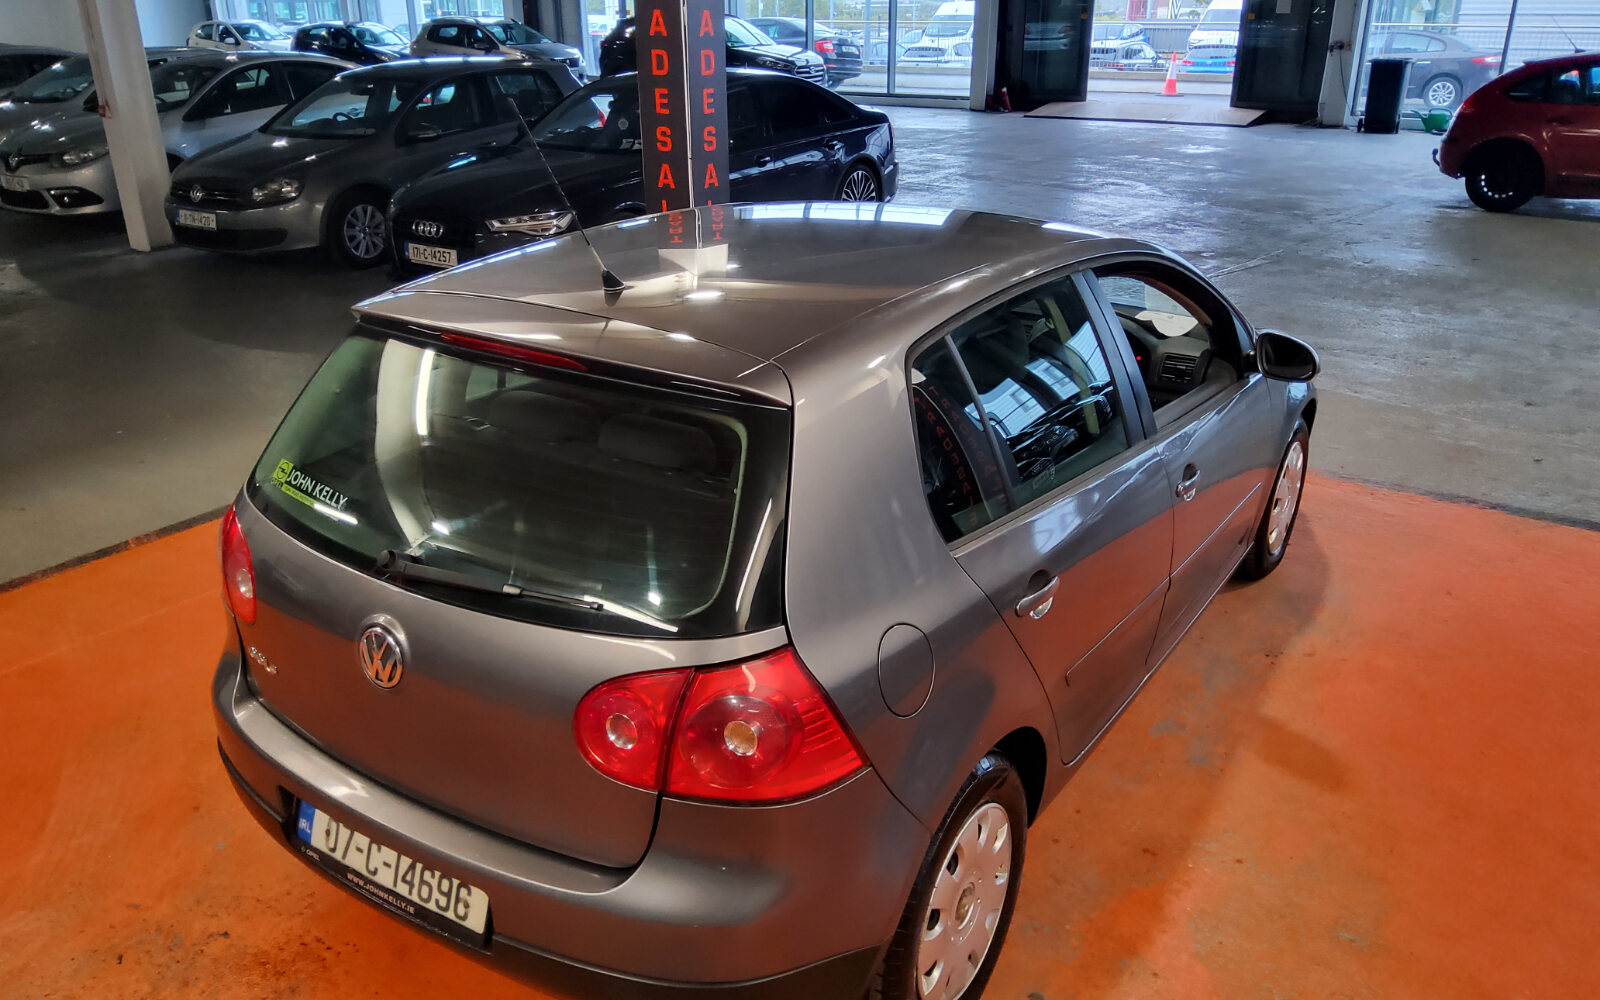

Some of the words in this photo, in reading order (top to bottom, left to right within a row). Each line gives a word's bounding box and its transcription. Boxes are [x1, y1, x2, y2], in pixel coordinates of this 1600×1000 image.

[700, 9, 719, 206] ADESA
[412, 245, 452, 264] 171-C-14257
[286, 468, 316, 494] JOHN
[313, 483, 348, 510] KELLY
[298, 817, 311, 833] IRL
[324, 815, 473, 922] 07-C-14696
[346, 872, 416, 915] WWW.JOHNKELLY.IE
